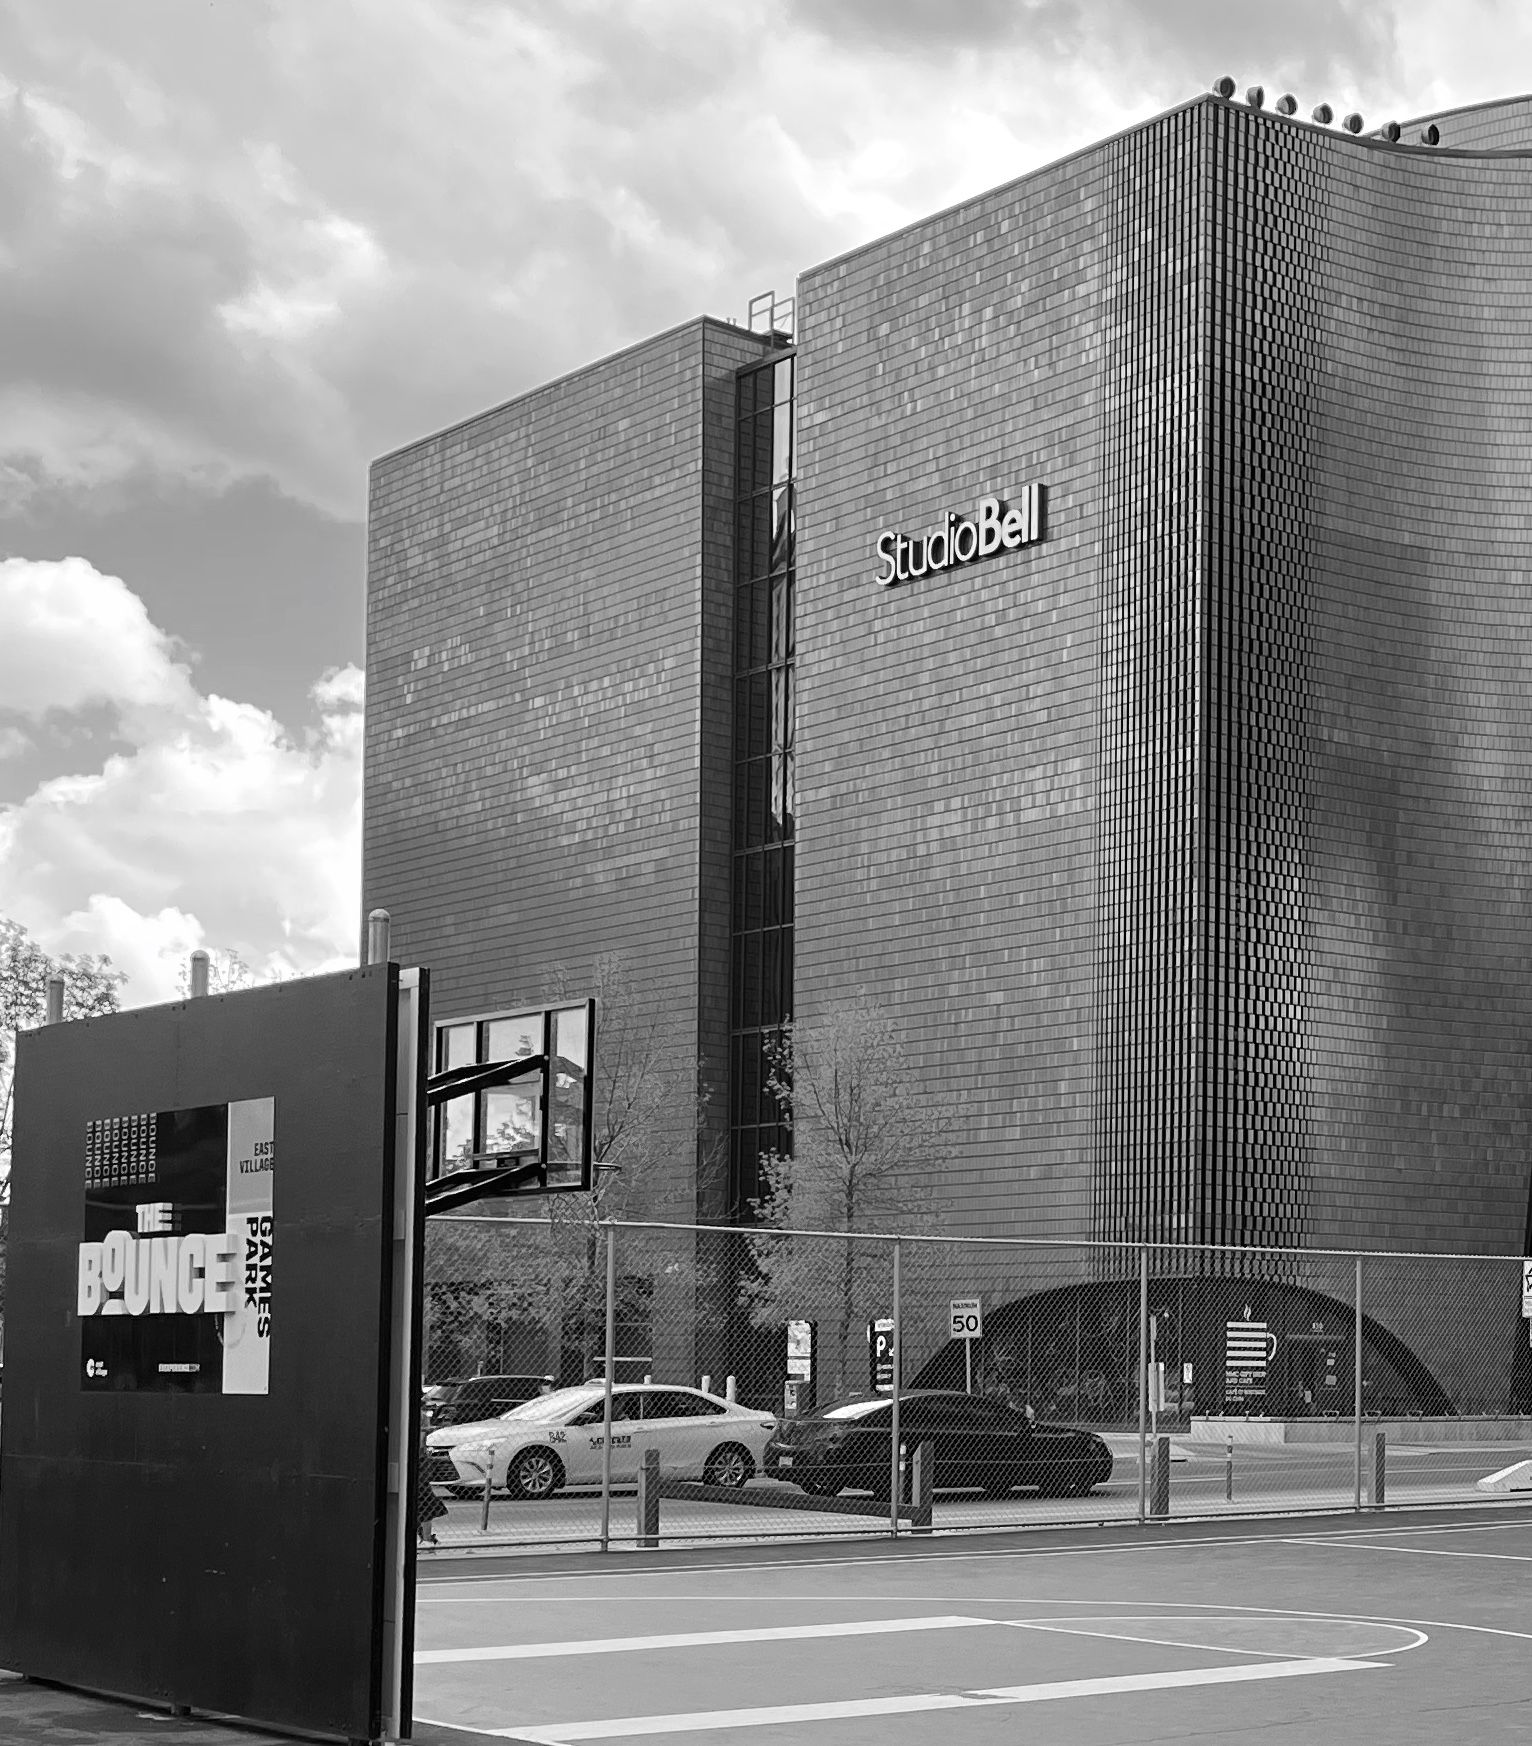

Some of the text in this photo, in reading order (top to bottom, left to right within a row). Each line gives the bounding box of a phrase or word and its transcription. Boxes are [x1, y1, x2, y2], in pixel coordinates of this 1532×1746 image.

[875, 483, 1040, 586] StudioBell
[253, 1141, 275, 1157] EAST
[239, 1157, 275, 1174] VILLAGE
[136, 1203, 176, 1233] THE
[77, 1230, 237, 1317] BOUNCE
[244, 1217, 259, 1309] PARK
[257, 1216, 274, 1338] GAMES
[952, 1315, 979, 1332] 50
[877, 1335, 887, 1357] P
